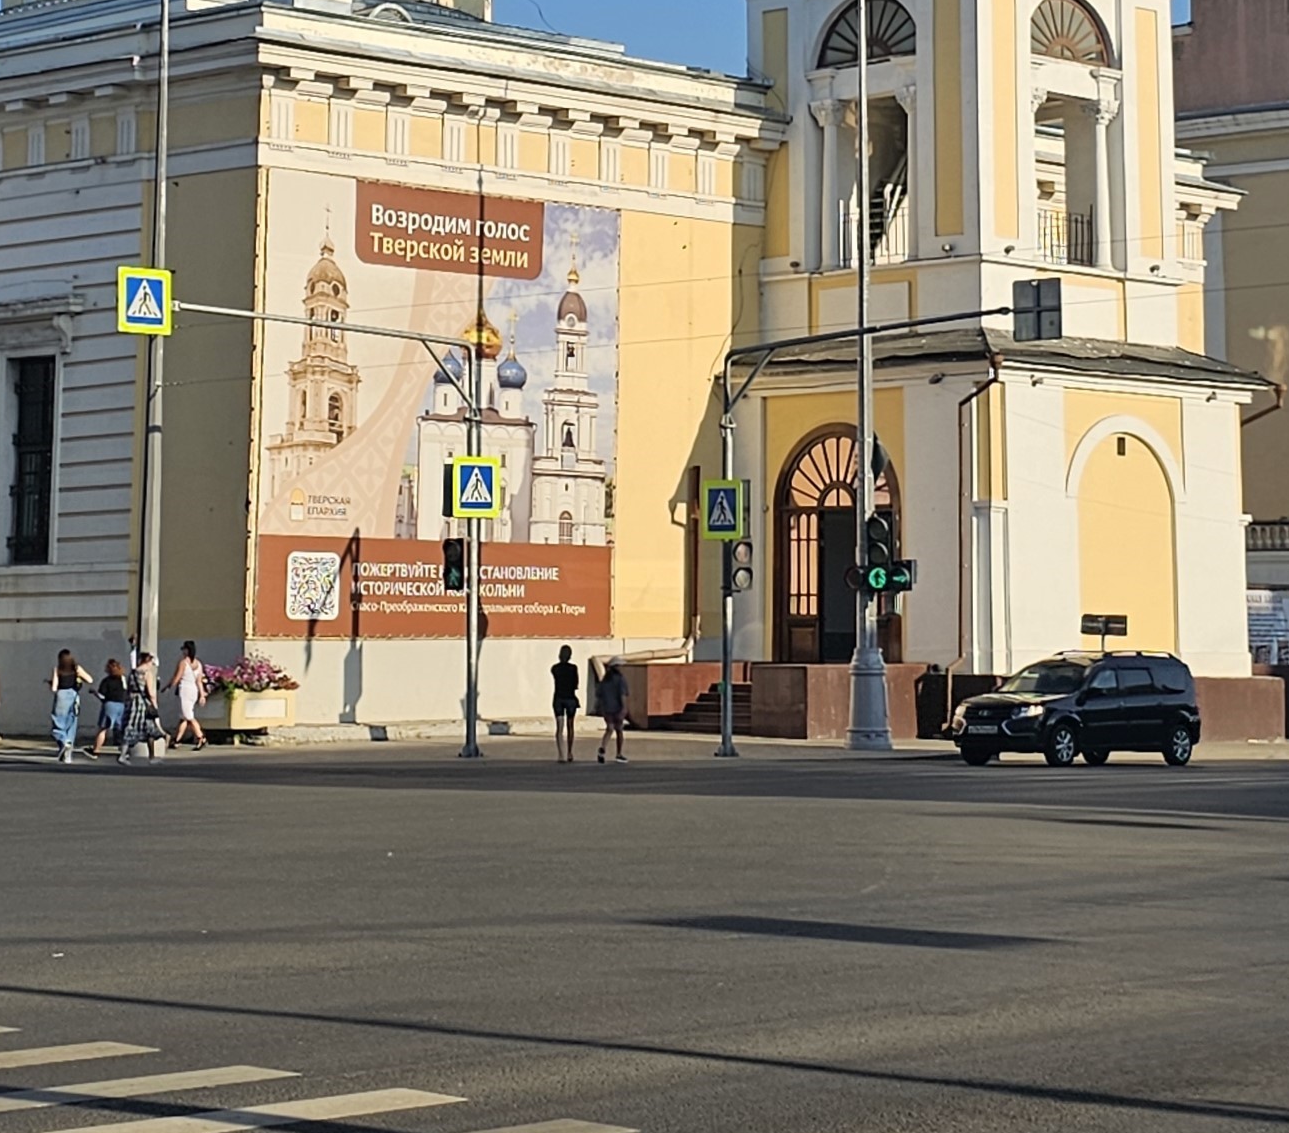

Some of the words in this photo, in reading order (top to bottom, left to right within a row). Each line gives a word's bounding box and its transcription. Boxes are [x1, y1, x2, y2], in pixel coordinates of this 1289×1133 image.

[371, 203, 471, 236] Возродим
[475, 220, 530, 242] голос
[369, 232, 465, 263] Тверской
[469, 246, 529, 269] земли
[308, 494, 351, 505] ТВЕРСКАЯ
[307, 506, 347, 516] ЕПАРХИЯ
[352, 562, 437, 579] ПОЖЕРТВУЙТЕ
[464, 565, 560, 581] СТАНОВЛЕНИЕ
[351, 580, 445, 597] ИСТОРИЧЕСКОЙ
